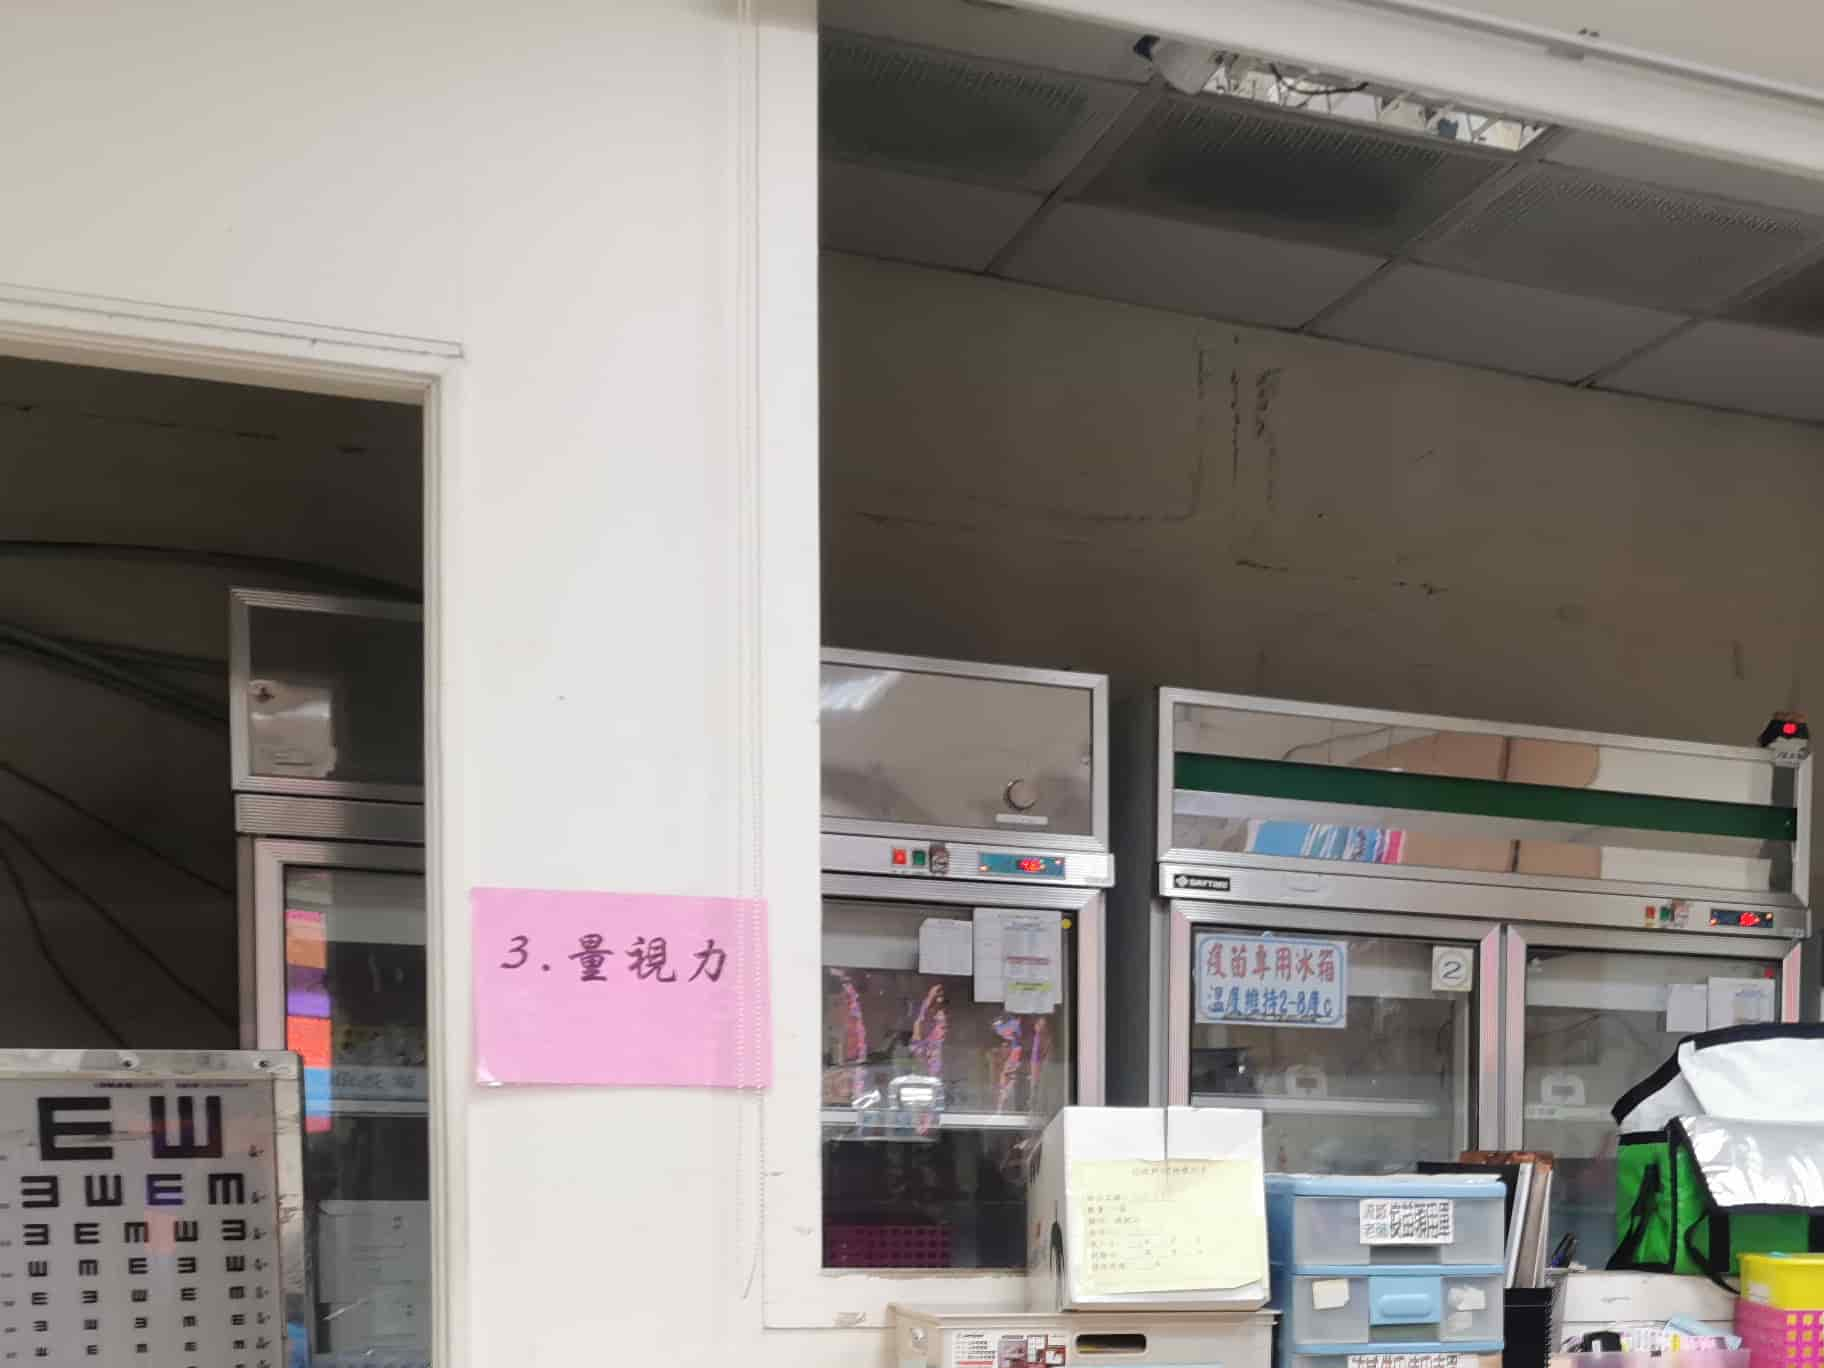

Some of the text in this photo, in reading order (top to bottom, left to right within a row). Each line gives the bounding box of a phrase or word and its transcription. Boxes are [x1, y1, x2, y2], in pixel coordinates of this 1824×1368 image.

[499, 933, 728, 983] 3.量視力
[1442, 960, 1463, 980] 2
